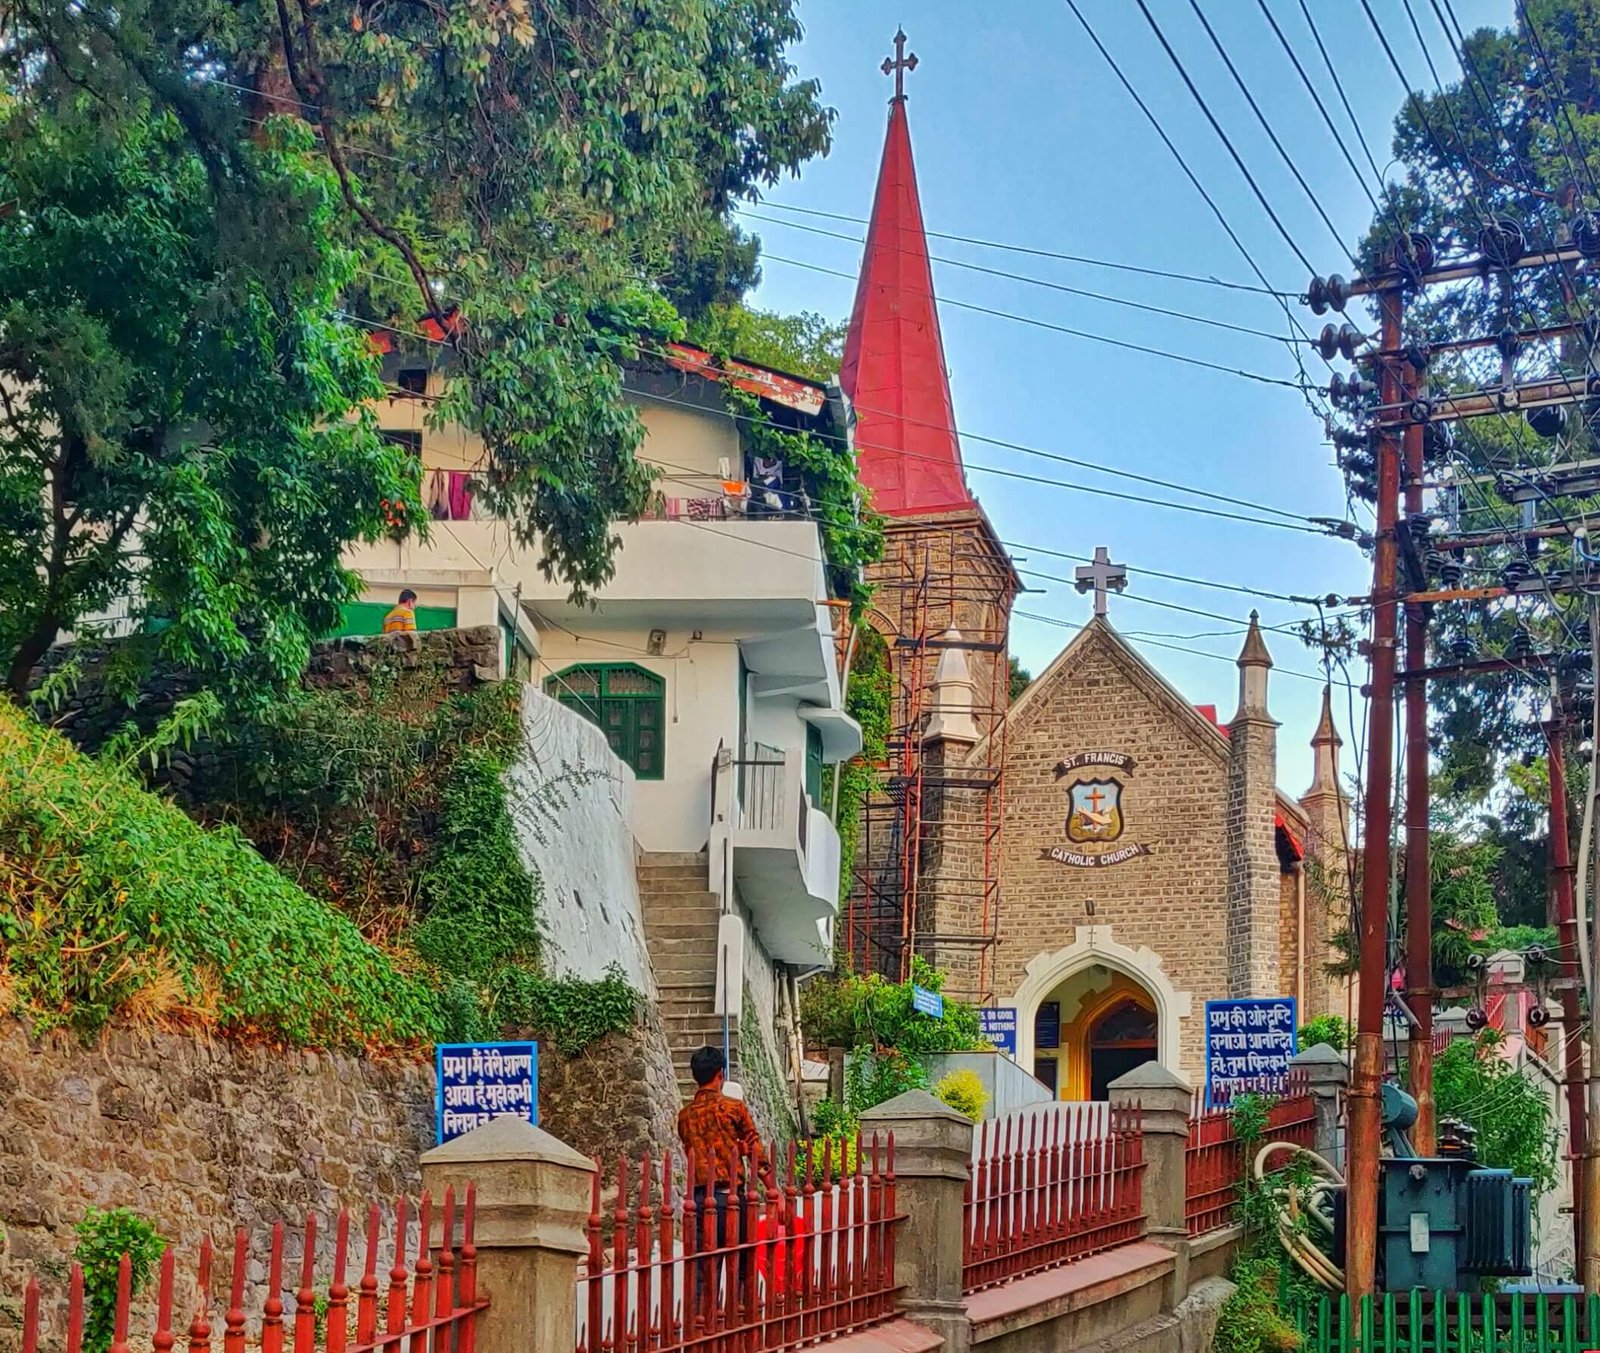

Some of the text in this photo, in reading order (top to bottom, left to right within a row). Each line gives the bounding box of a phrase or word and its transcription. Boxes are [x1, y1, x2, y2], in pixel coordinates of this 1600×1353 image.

[1063, 756, 1079, 769] ST.
[1051, 844, 1139, 866] CATHOLIC CHURCH
[1209, 1010, 1230, 1031] प्रभु
[1230, 1006, 1247, 1028] की
[472, 1048, 483, 1078] मैं
[483, 1049, 504, 1078] तेरी
[503, 1054, 532, 1078] शरण
[444, 1085, 475, 1107] आया
[507, 1078, 532, 1105] कभी
